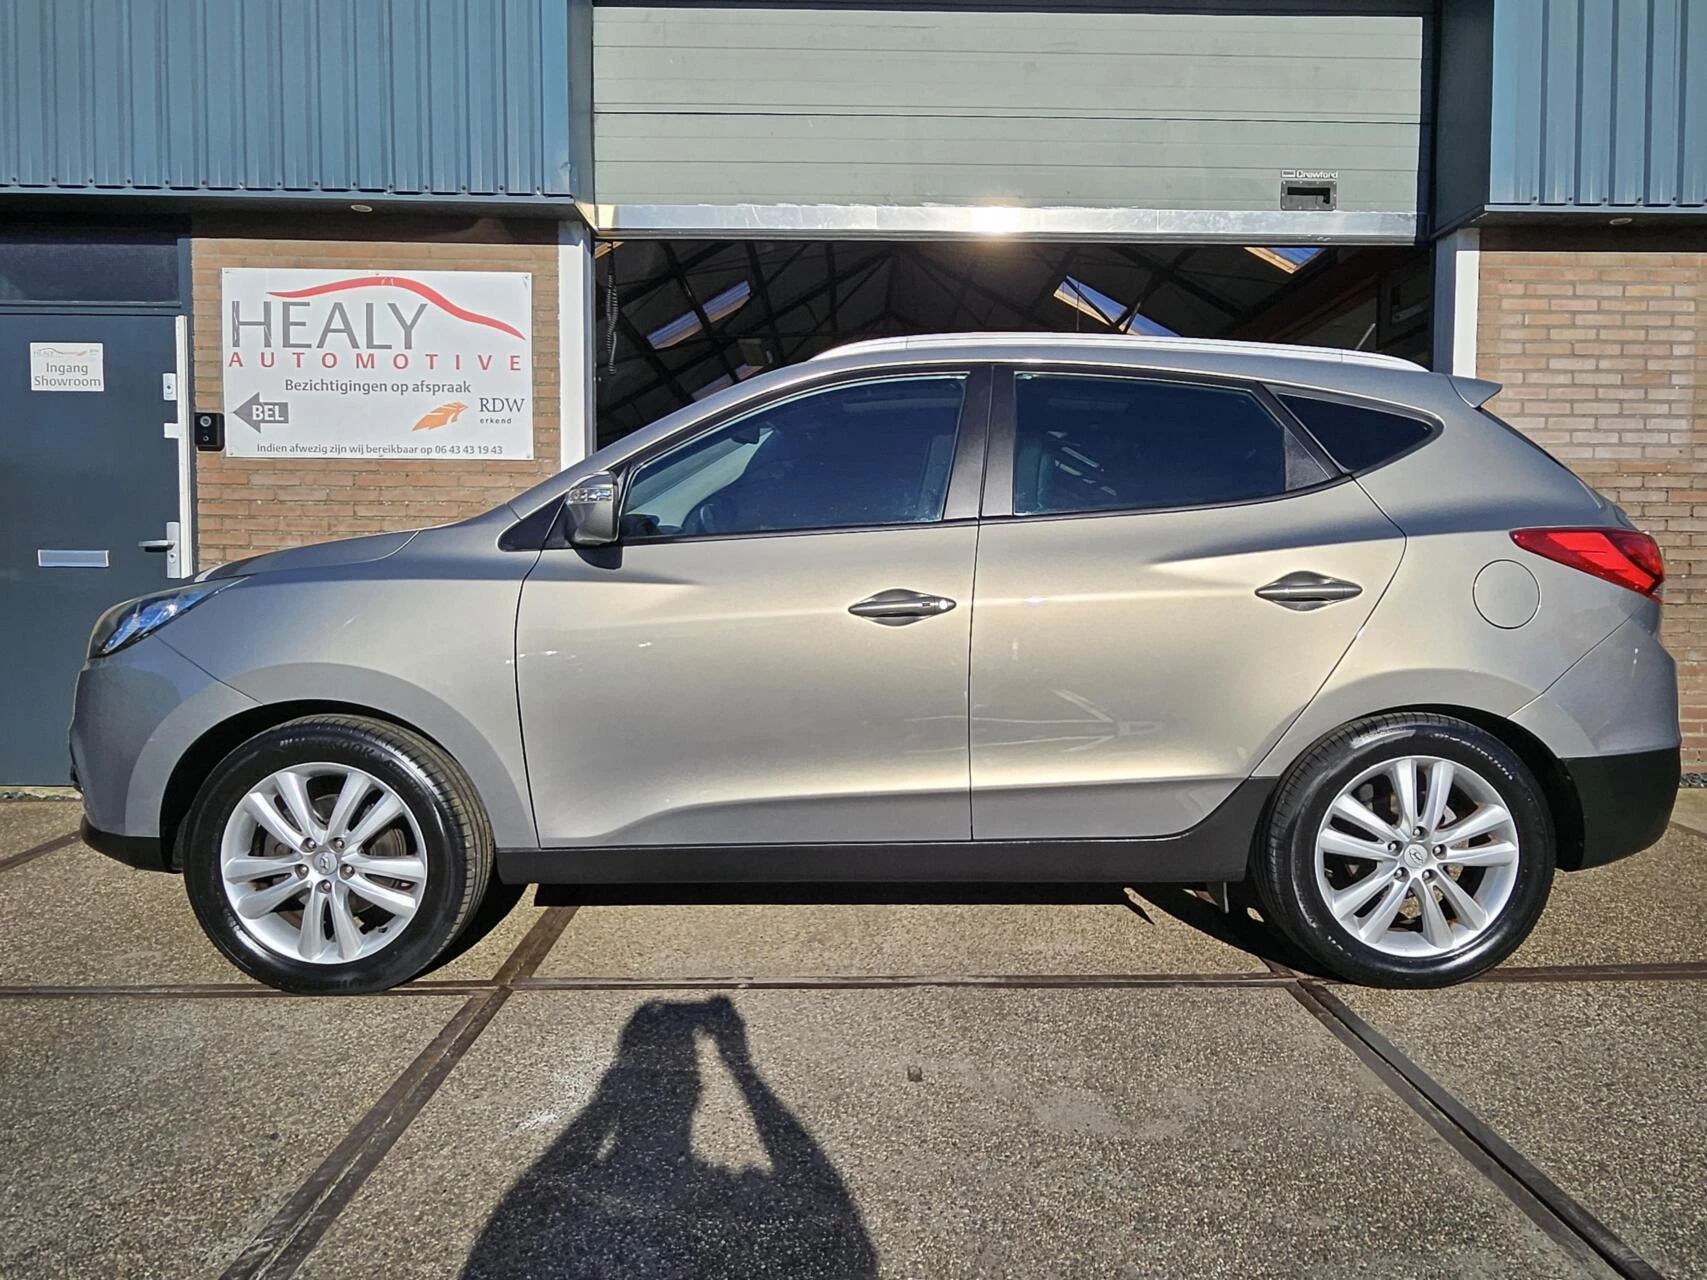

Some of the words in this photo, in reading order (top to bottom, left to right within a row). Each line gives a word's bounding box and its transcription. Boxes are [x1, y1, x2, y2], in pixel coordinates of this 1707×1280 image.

[231, 300, 428, 350] HEALY
[228, 351, 521, 371] AUTOMOTIVE
[46, 362, 88, 376] Ingang
[34, 375, 101, 387] Showroom
[284, 378, 388, 395] Bezichtigingen
[391, 381, 409, 396] op
[412, 380, 472, 396] afspraak
[252, 405, 285, 420] BEL
[479, 397, 525, 413] RDW
[257, 443, 287, 453] Indien
[289, 443, 327, 455] afwezig
[330, 444, 347, 455] zijn
[349, 444, 364, 455] wij
[366, 444, 418, 455] bereikbaar
[420, 446, 433, 455] op
[434, 445, 448, 455] 06
[448, 445, 461, 455] 43
[462, 445, 475, 455] 43
[477, 445, 490, 455] 19
[490, 445, 503, 455] 43
